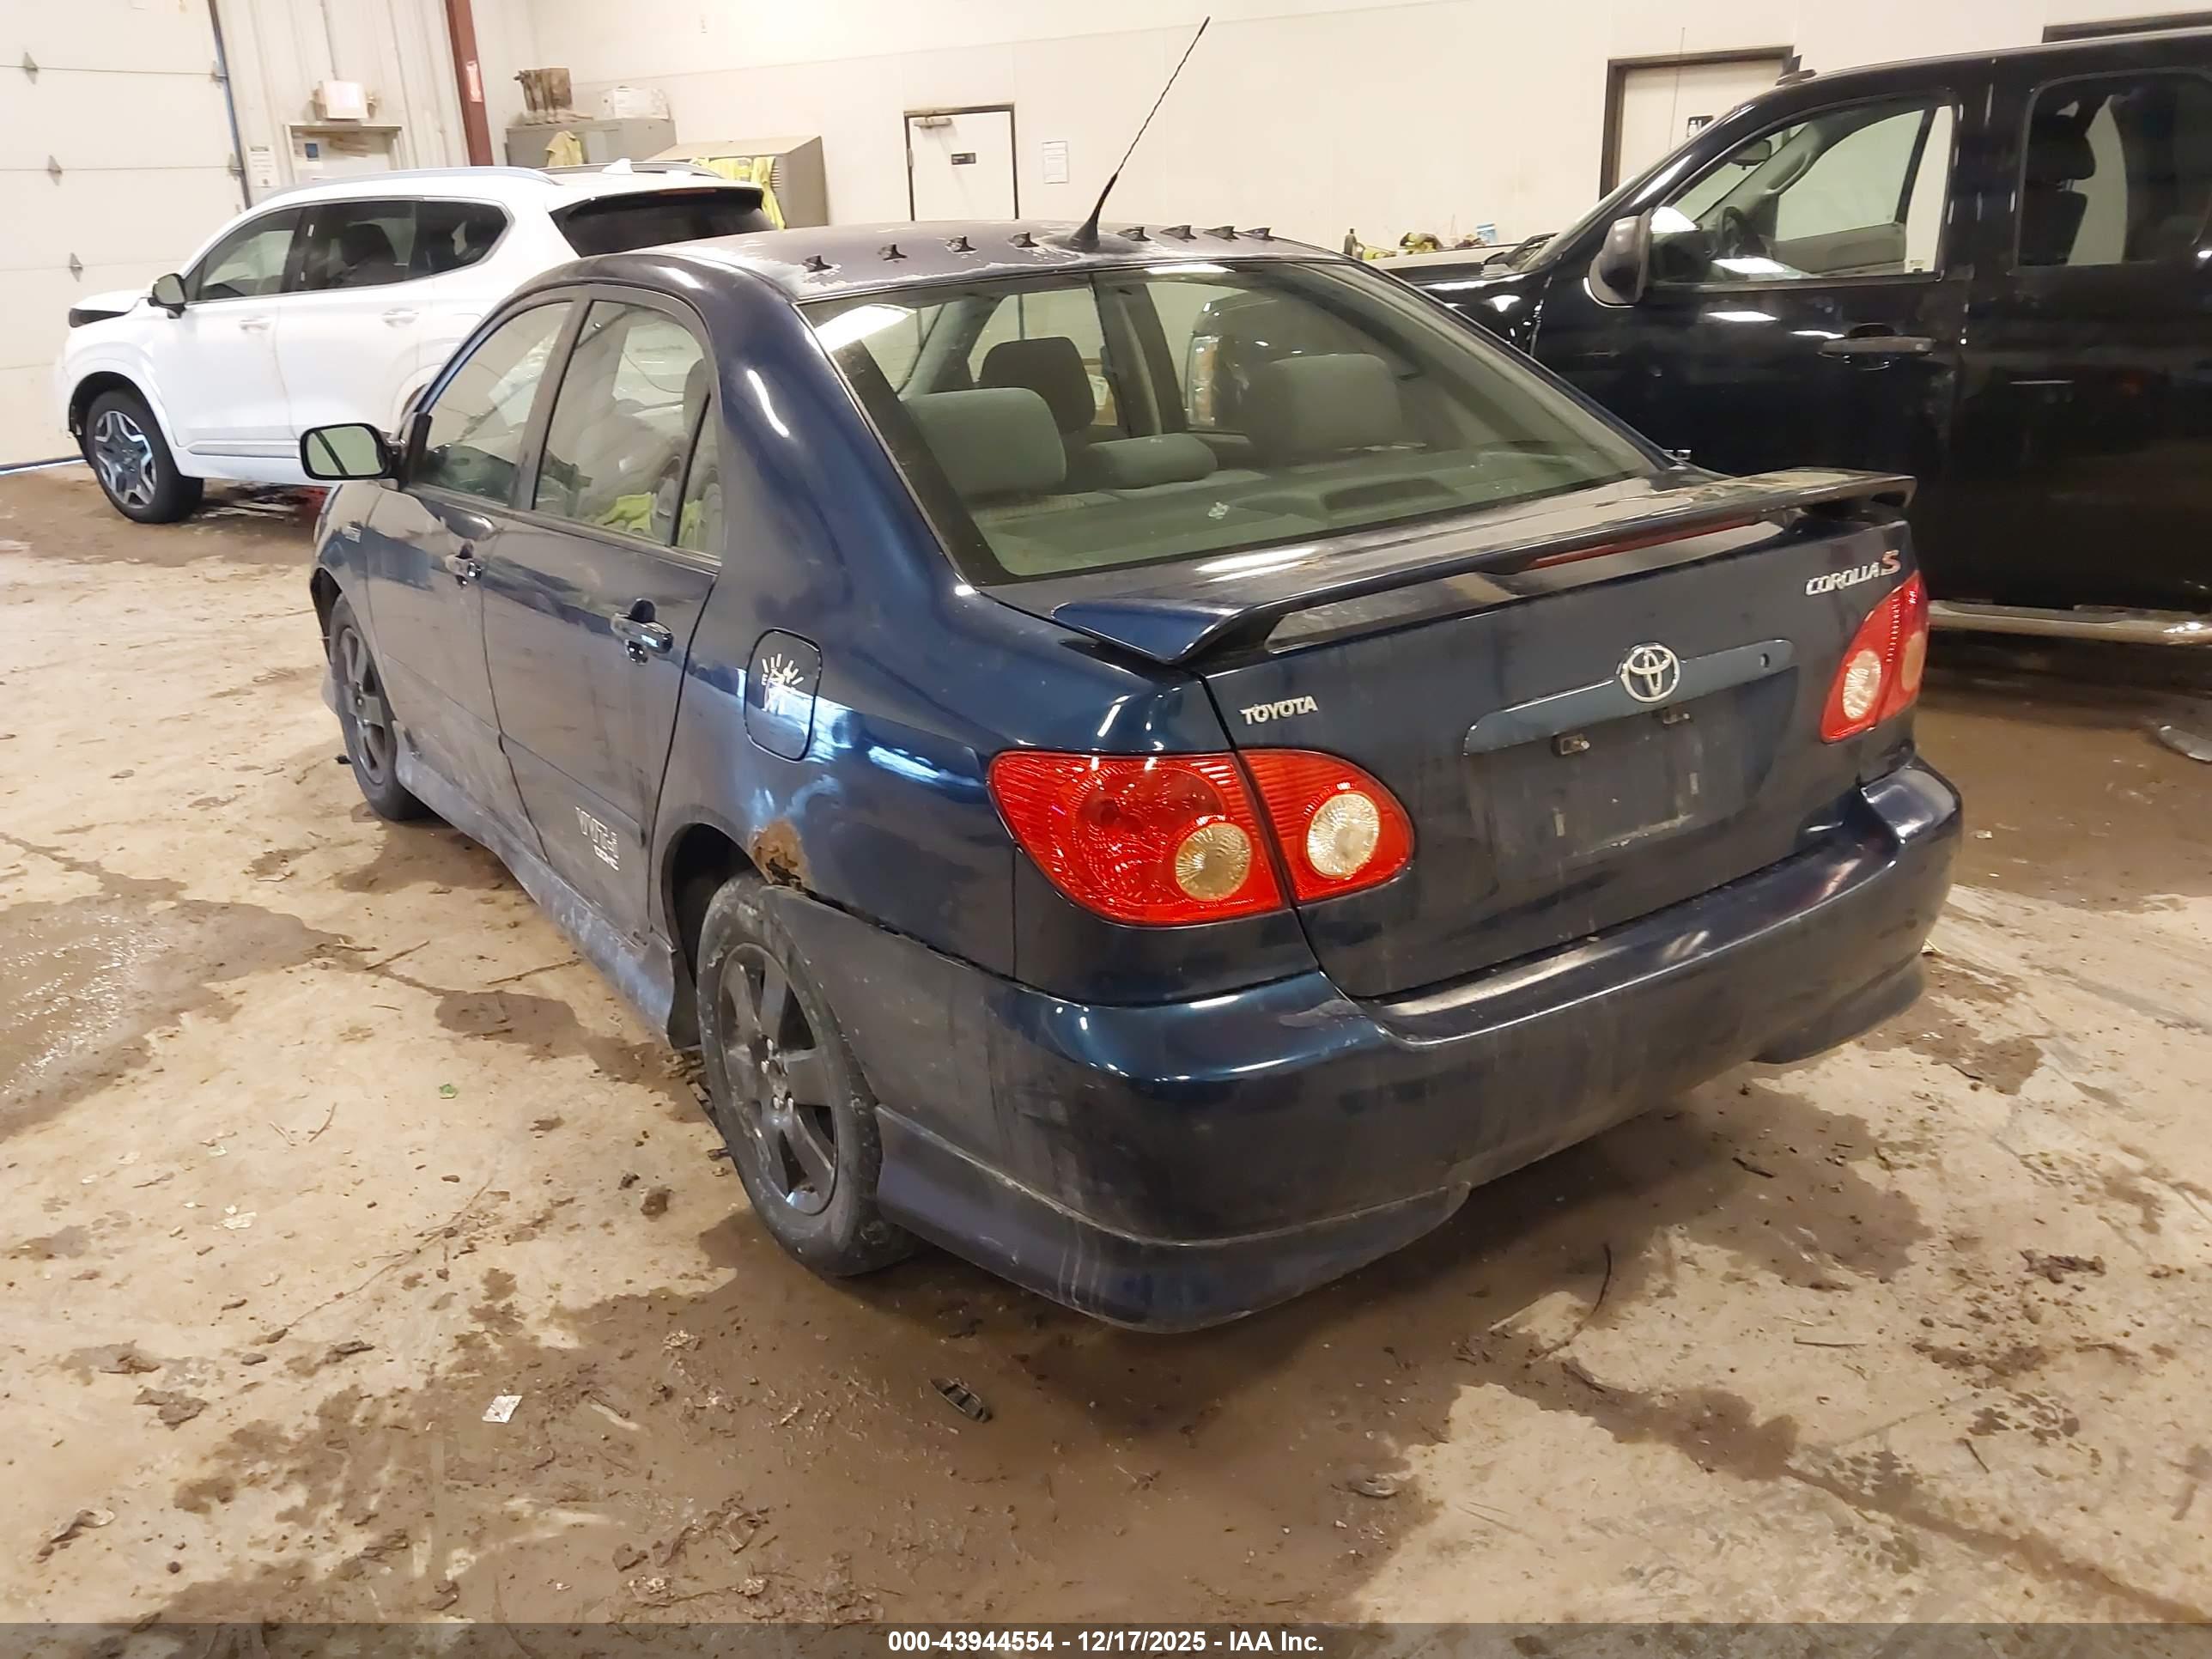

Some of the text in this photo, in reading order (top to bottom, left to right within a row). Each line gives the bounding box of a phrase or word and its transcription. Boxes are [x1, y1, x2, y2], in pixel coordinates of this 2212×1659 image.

[1805, 549, 1902, 596] COROLLA S
[1238, 696, 1319, 726] TOYOTA
